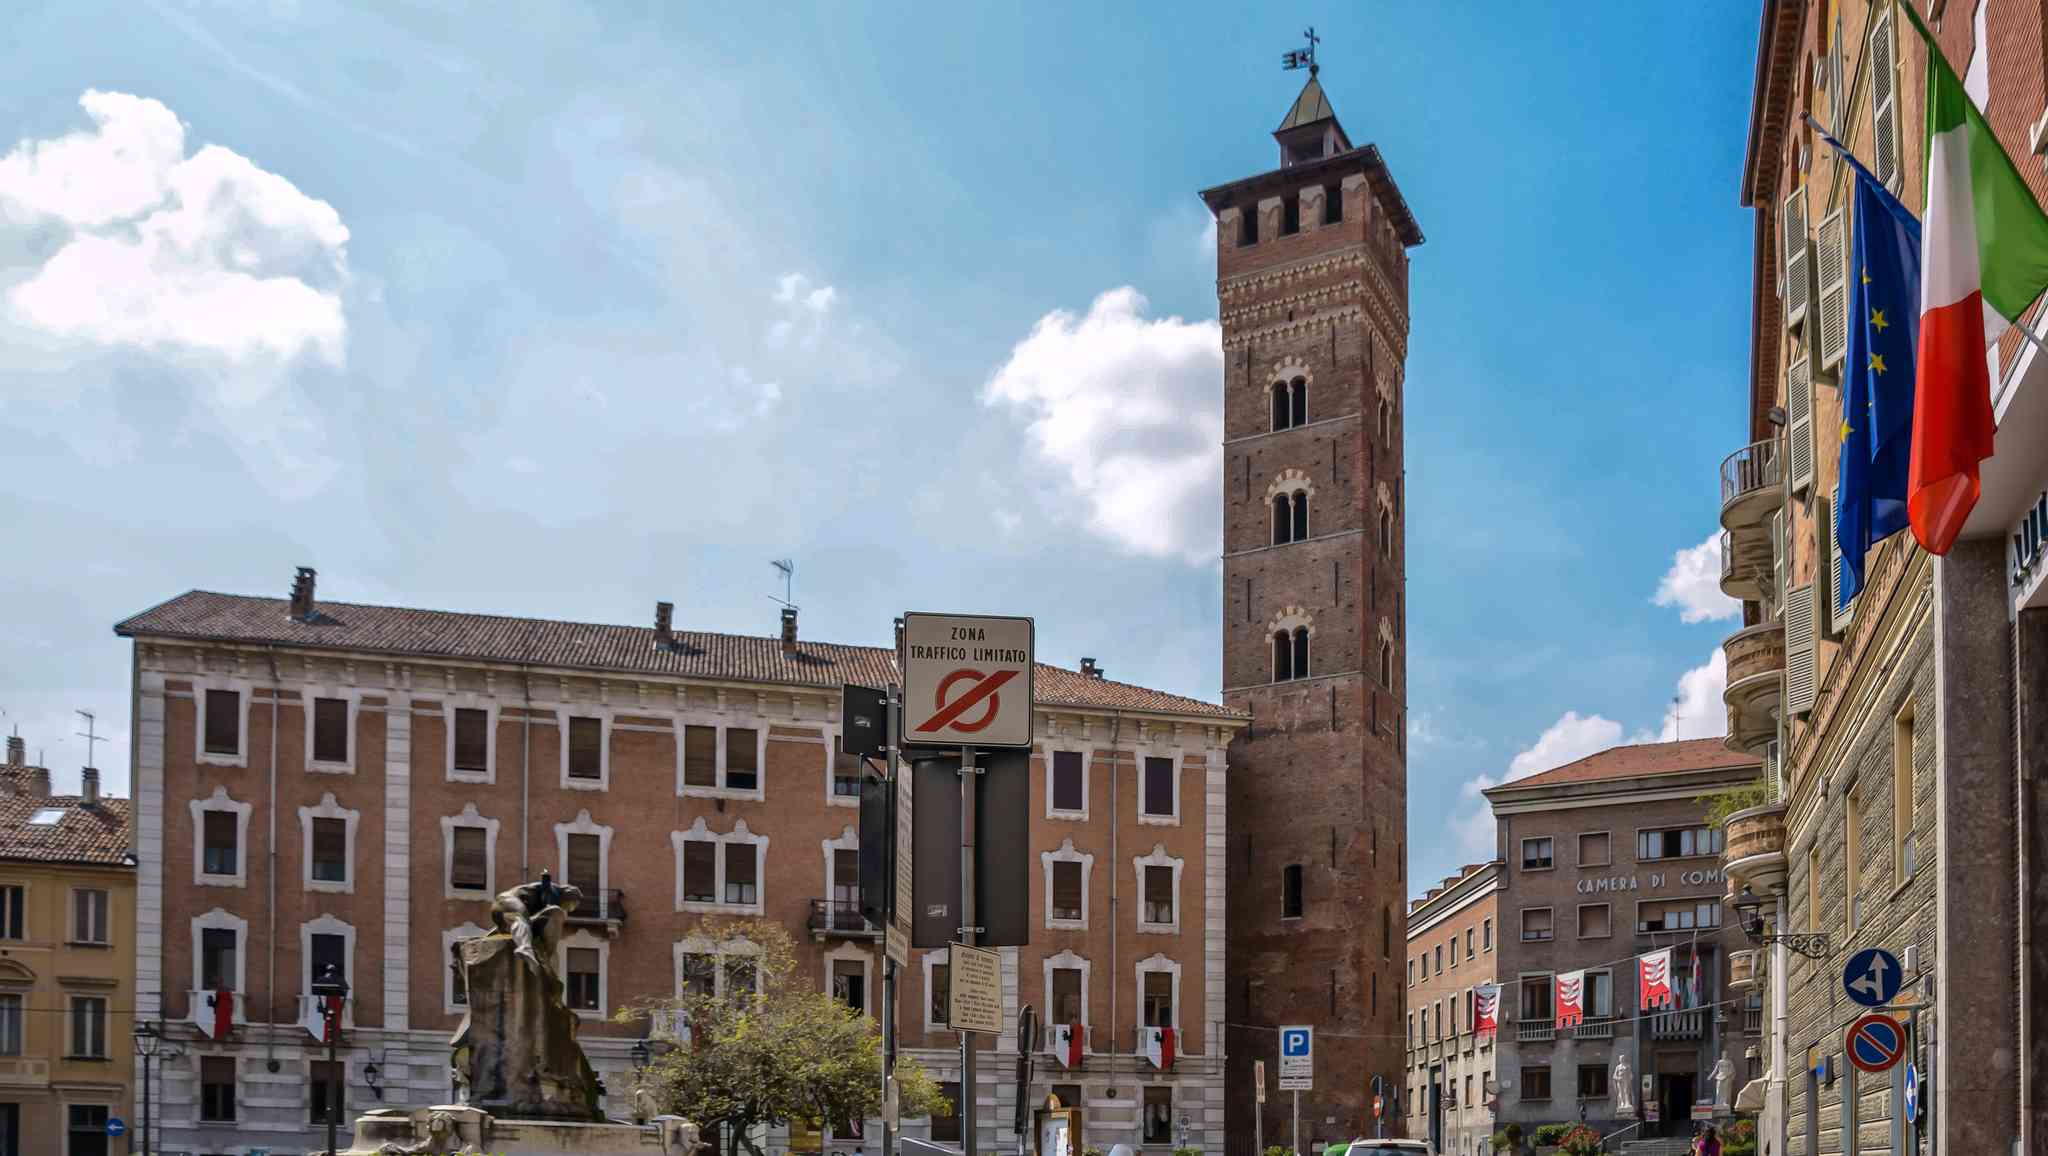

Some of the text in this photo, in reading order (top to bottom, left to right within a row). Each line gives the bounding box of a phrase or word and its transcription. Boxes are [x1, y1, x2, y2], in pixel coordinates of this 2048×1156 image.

[951, 626, 985, 641] ZONA
[910, 645, 1026, 663] TRAFFICO LIMITATO
[1576, 876, 1638, 893] CAMERA
[1652, 872, 1665, 888] DI
[1289, 1034, 1304, 1053] P
